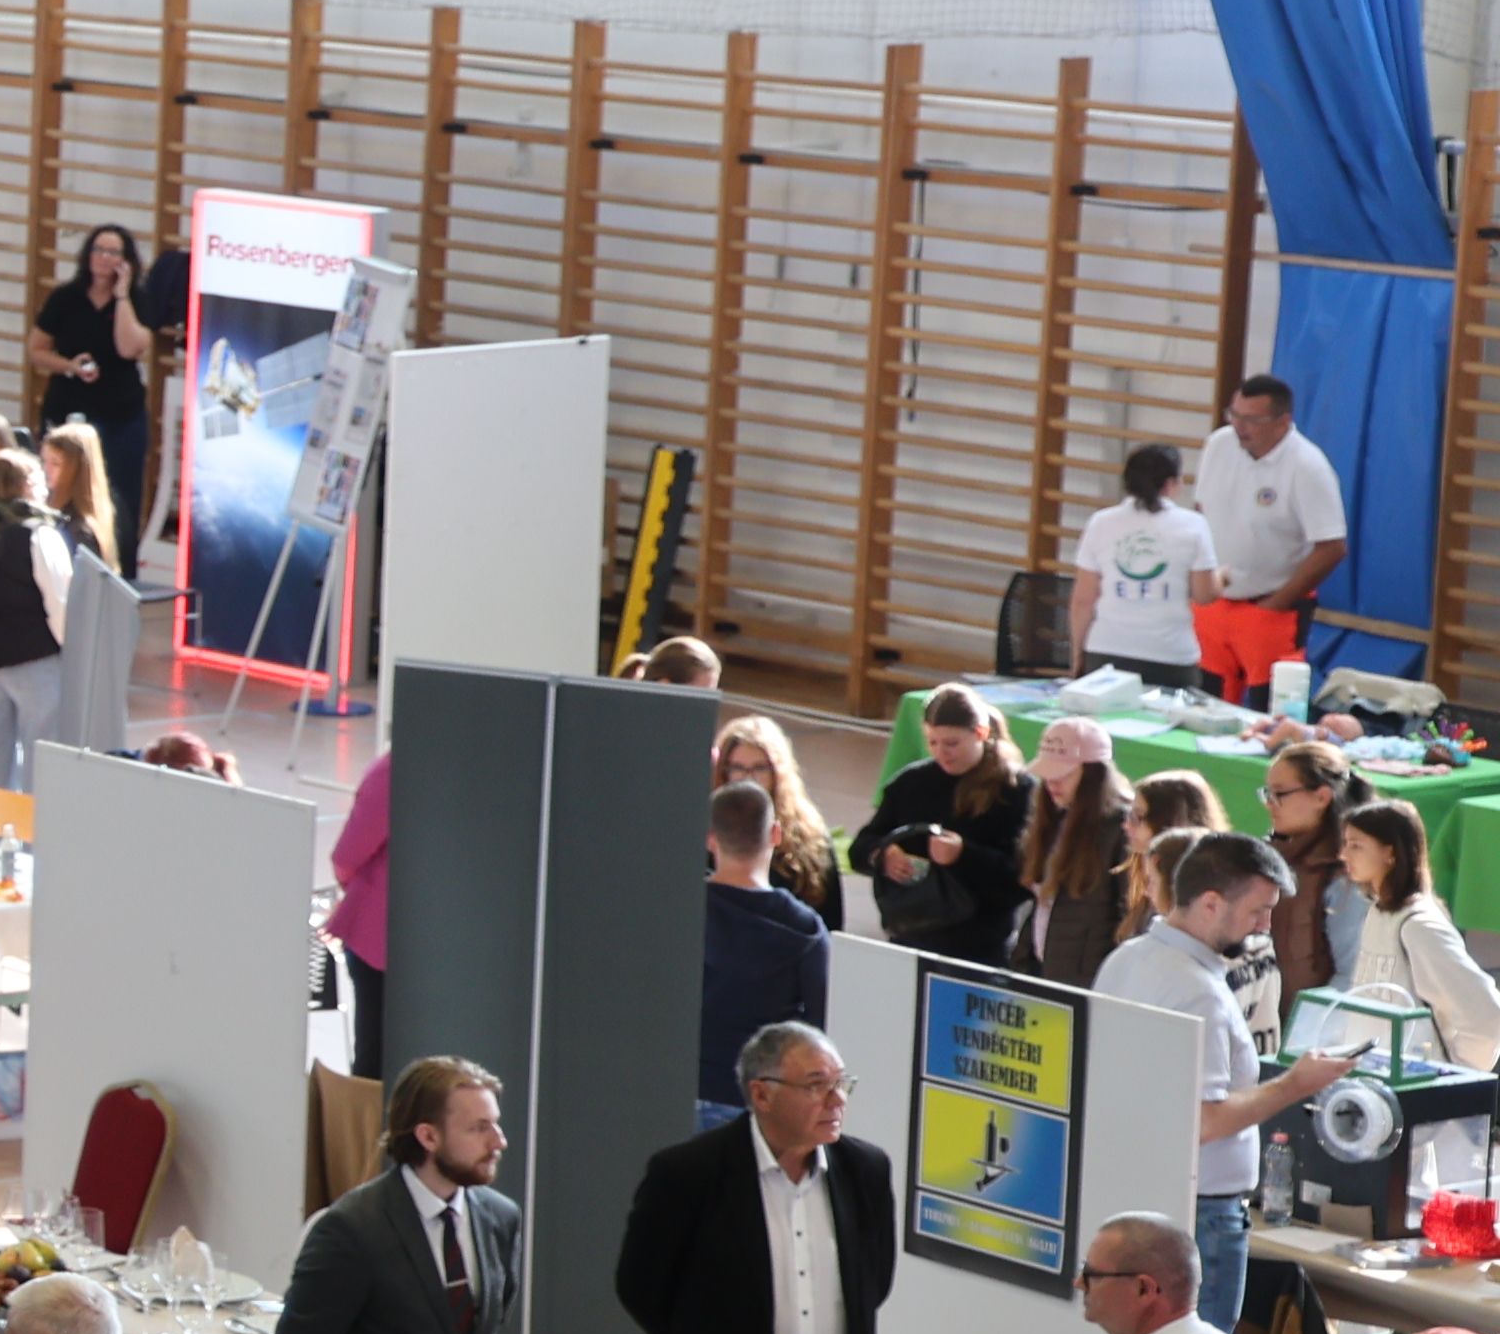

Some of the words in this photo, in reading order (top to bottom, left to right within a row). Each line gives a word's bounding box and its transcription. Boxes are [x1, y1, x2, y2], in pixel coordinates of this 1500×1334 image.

[206, 233, 351, 277] Rosenberger
[965, 991, 1027, 1030] PINCÉR
[952, 1023, 1043, 1066] VENDÉGTÉRI
[954, 1055, 1038, 1095] SZAKEMBER
